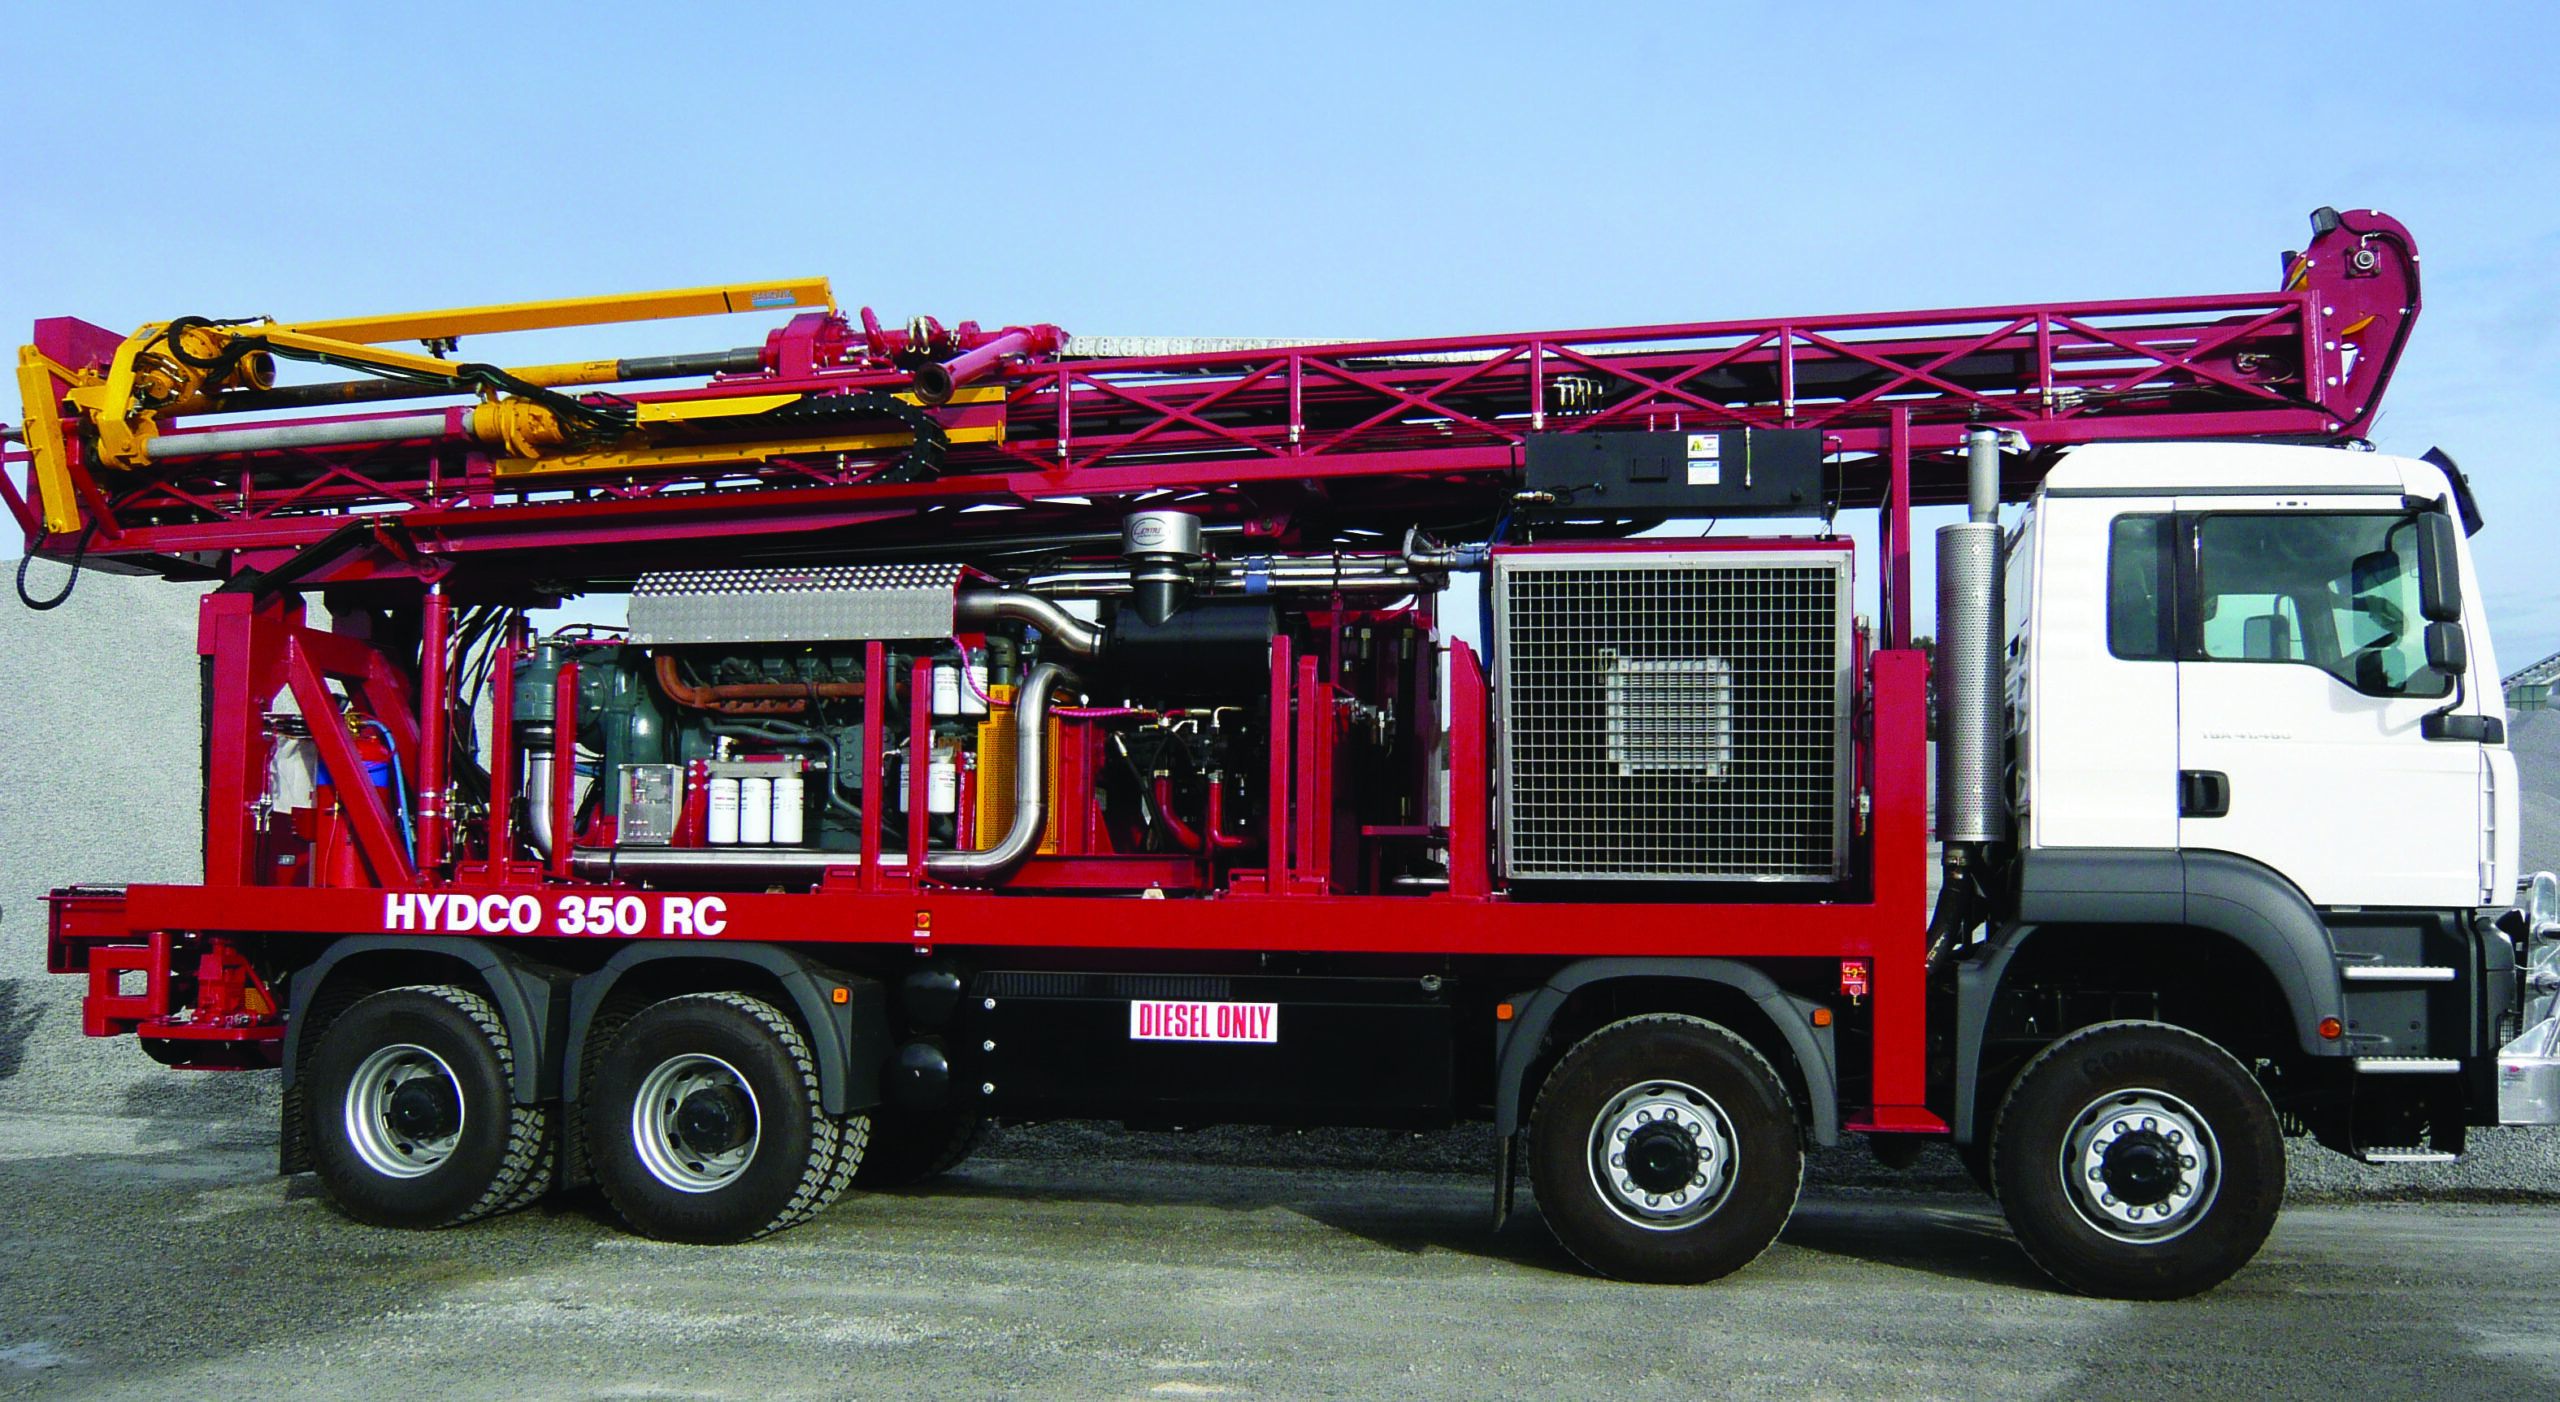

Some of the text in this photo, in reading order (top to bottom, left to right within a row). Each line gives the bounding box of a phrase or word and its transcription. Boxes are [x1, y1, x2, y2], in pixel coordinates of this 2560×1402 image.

[385, 893, 727, 937] HYDCO 350 RC
[1139, 1003, 1271, 1039] DIESEL ONLY
